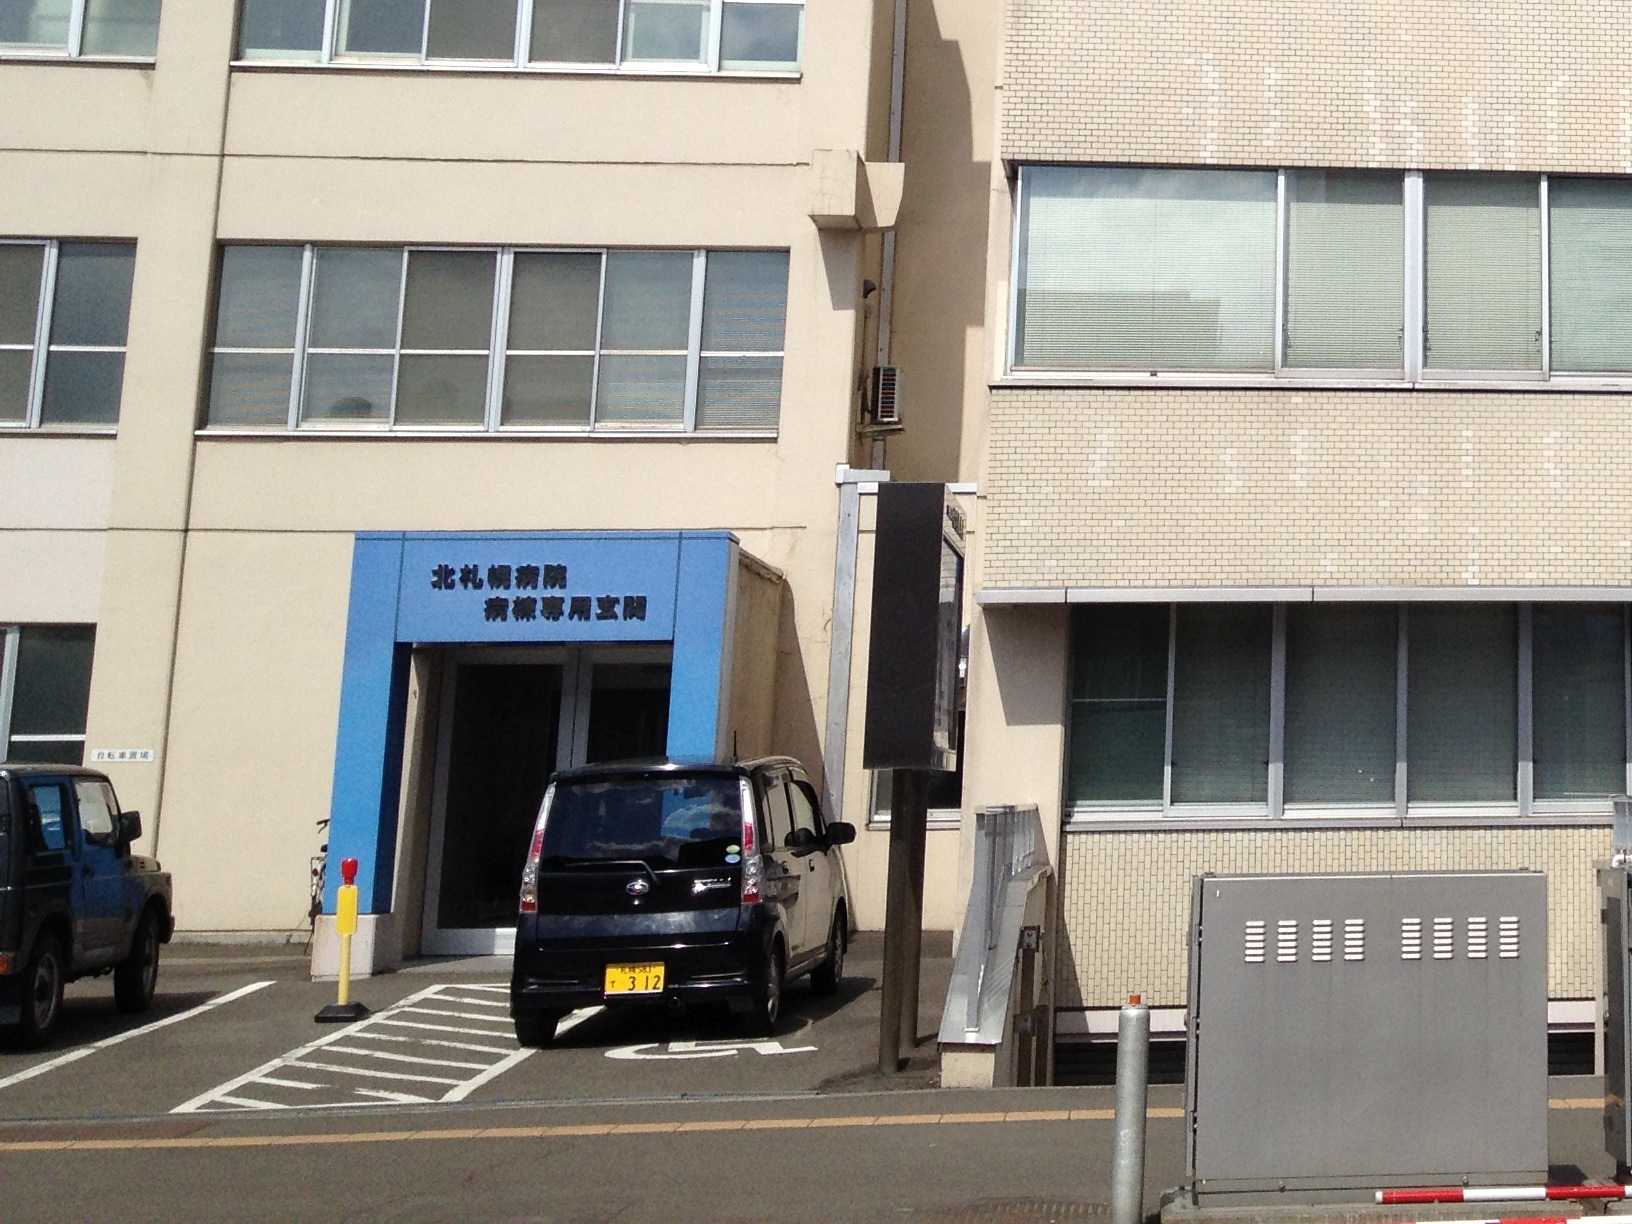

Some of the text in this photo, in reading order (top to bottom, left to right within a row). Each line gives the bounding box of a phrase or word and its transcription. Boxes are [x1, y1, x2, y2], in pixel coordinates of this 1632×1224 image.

[431, 563, 567, 590] 北札幌病院
